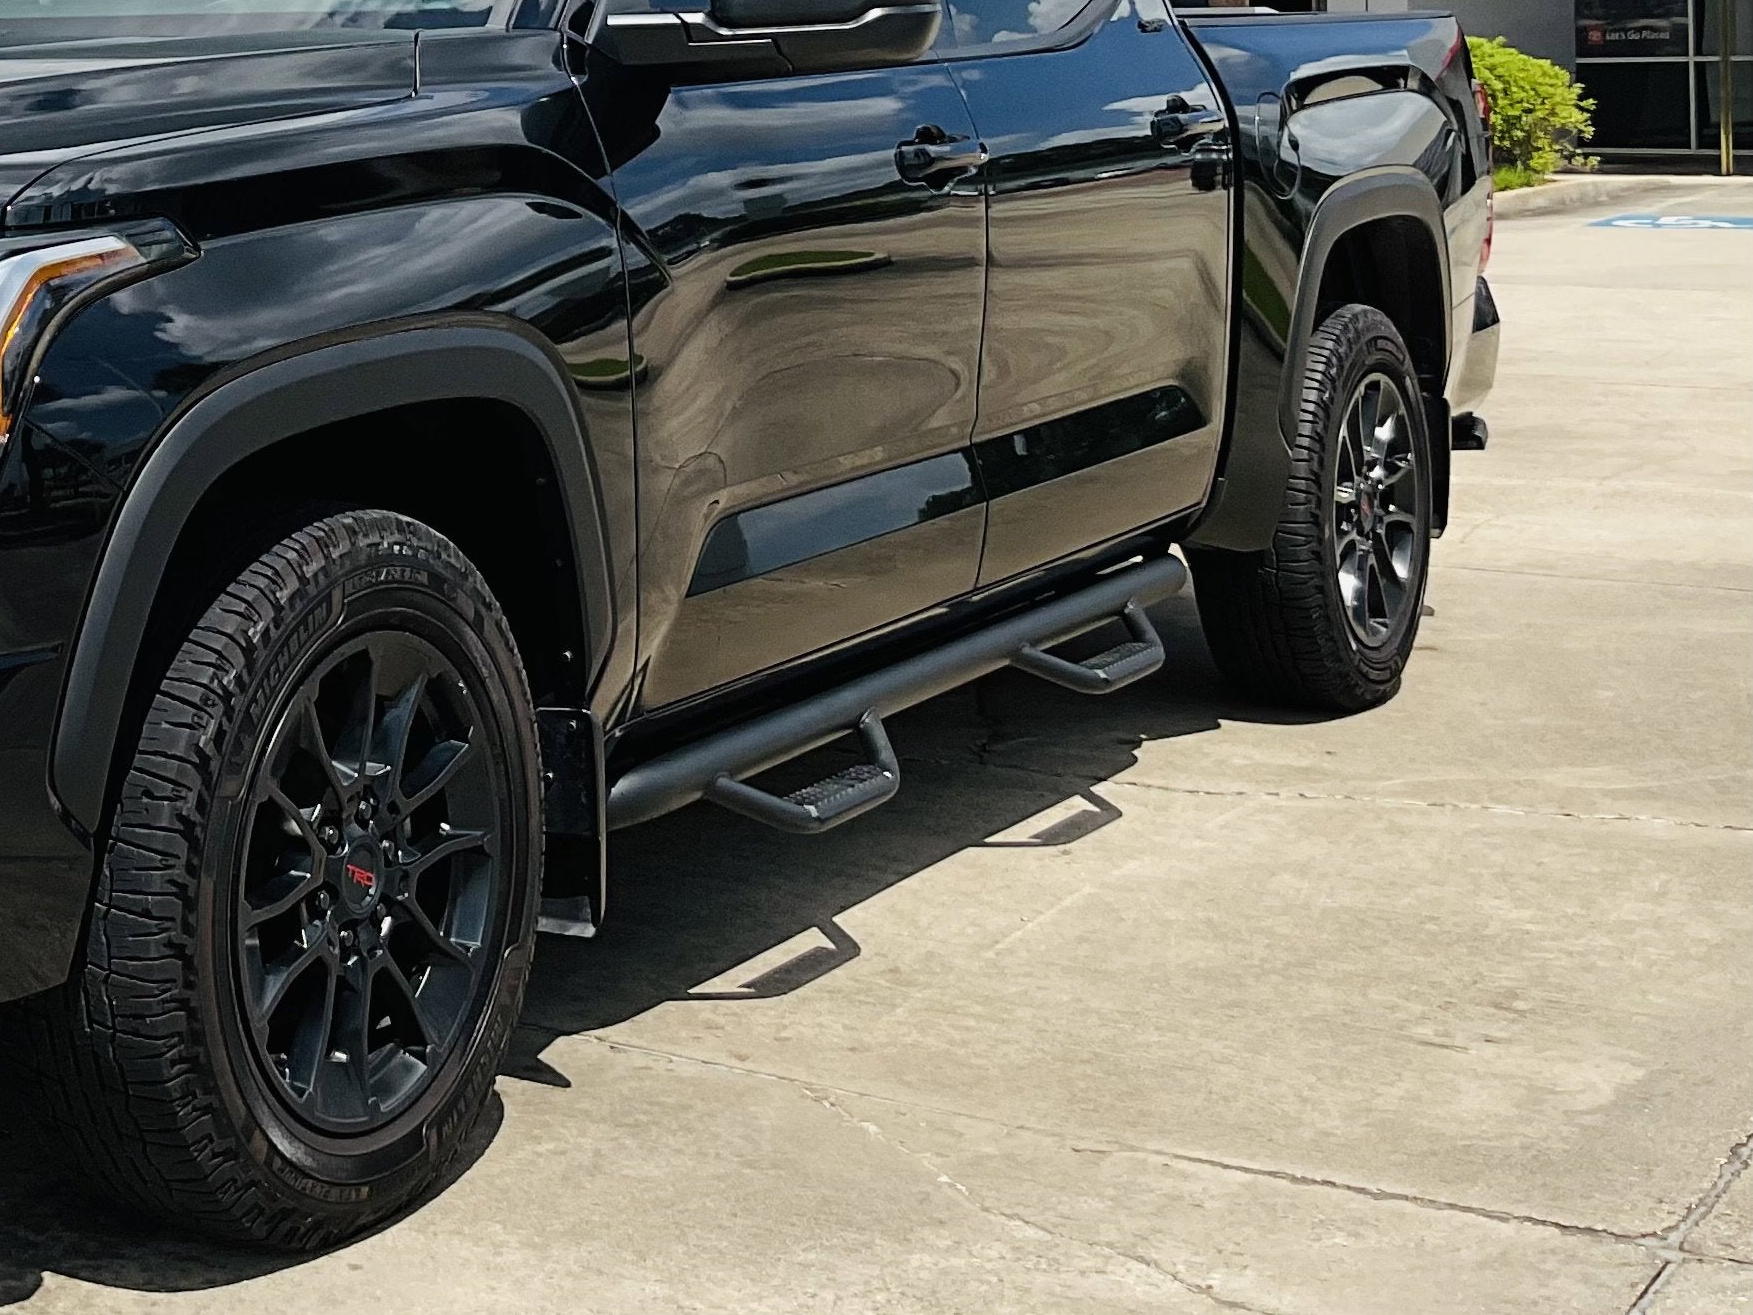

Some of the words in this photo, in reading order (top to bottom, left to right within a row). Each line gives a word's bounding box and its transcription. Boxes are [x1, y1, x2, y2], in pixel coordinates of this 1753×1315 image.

[1627, 29, 1640, 40] Go
[249, 601, 328, 722] MICHELIN
[345, 862, 376, 888] TRD
